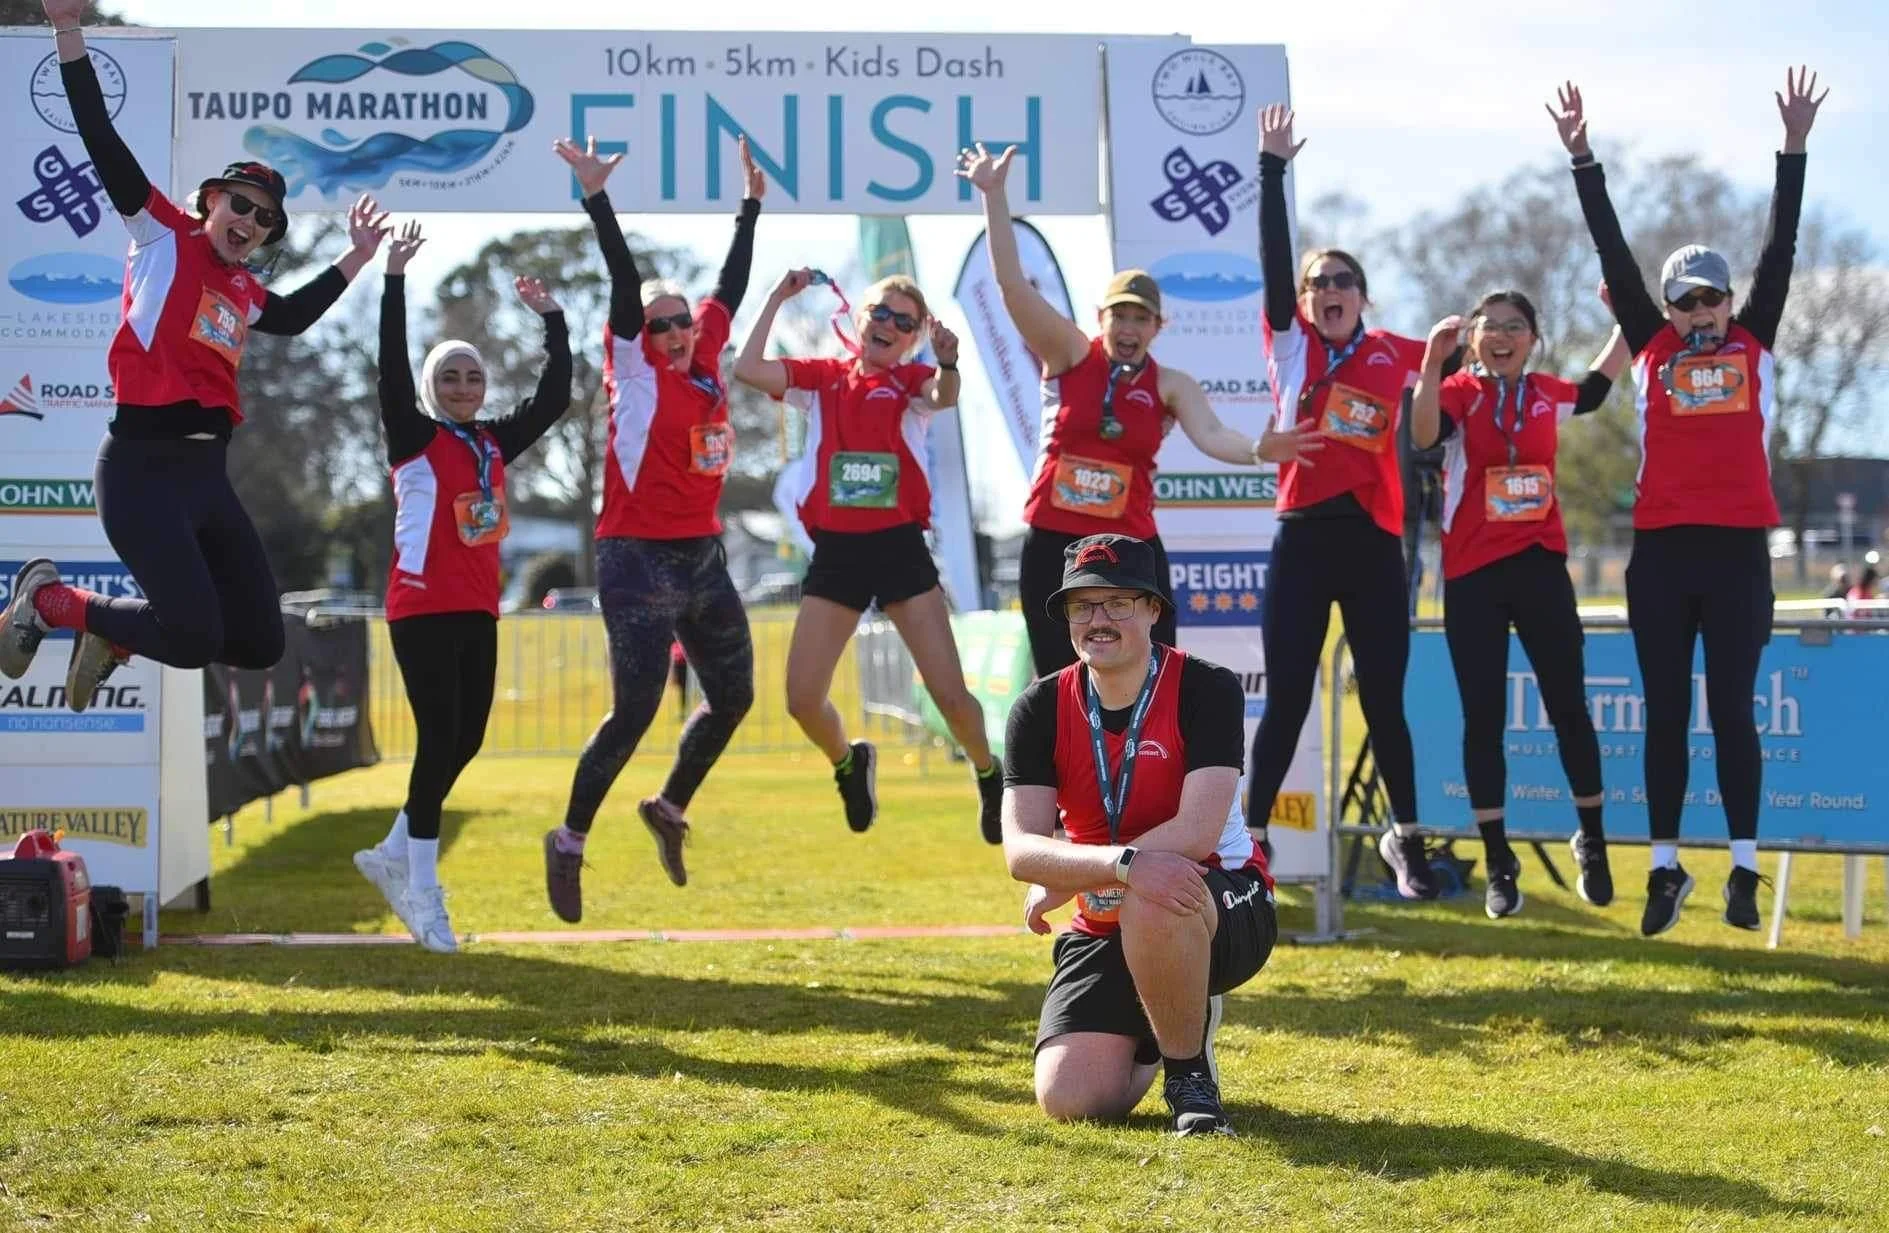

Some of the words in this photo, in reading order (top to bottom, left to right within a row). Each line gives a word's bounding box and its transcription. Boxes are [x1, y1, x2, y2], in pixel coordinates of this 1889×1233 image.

[605, 43, 696, 77] 10km
[725, 43, 796, 77] 5km
[826, 44, 899, 77] Kids
[916, 45, 1004, 79] Dash
[187, 91, 293, 120] TAUPO
[306, 91, 488, 120] MARATHON
[570, 93, 1041, 202] FINISH
[0, 327, 107, 339] CCOMMODA
[41, 384, 99, 398] ROAD
[1200, 379, 1242, 393] OAD
[841, 463, 882, 482] 2694
[1073, 468, 1112, 492] 1023
[0, 484, 64, 505] OHN
[1156, 479, 1216, 499] OHN
[1220, 476, 1277, 499] WES
[1169, 563, 1269, 590] PEIGHT
[8, 717, 25, 730] no
[1611, 787, 1626, 800] in
[1766, 790, 1804, 808] Year
[1273, 796, 1311, 829] LEY
[0, 811, 61, 836] ATURE
[66, 811, 142, 843] VALLEY
